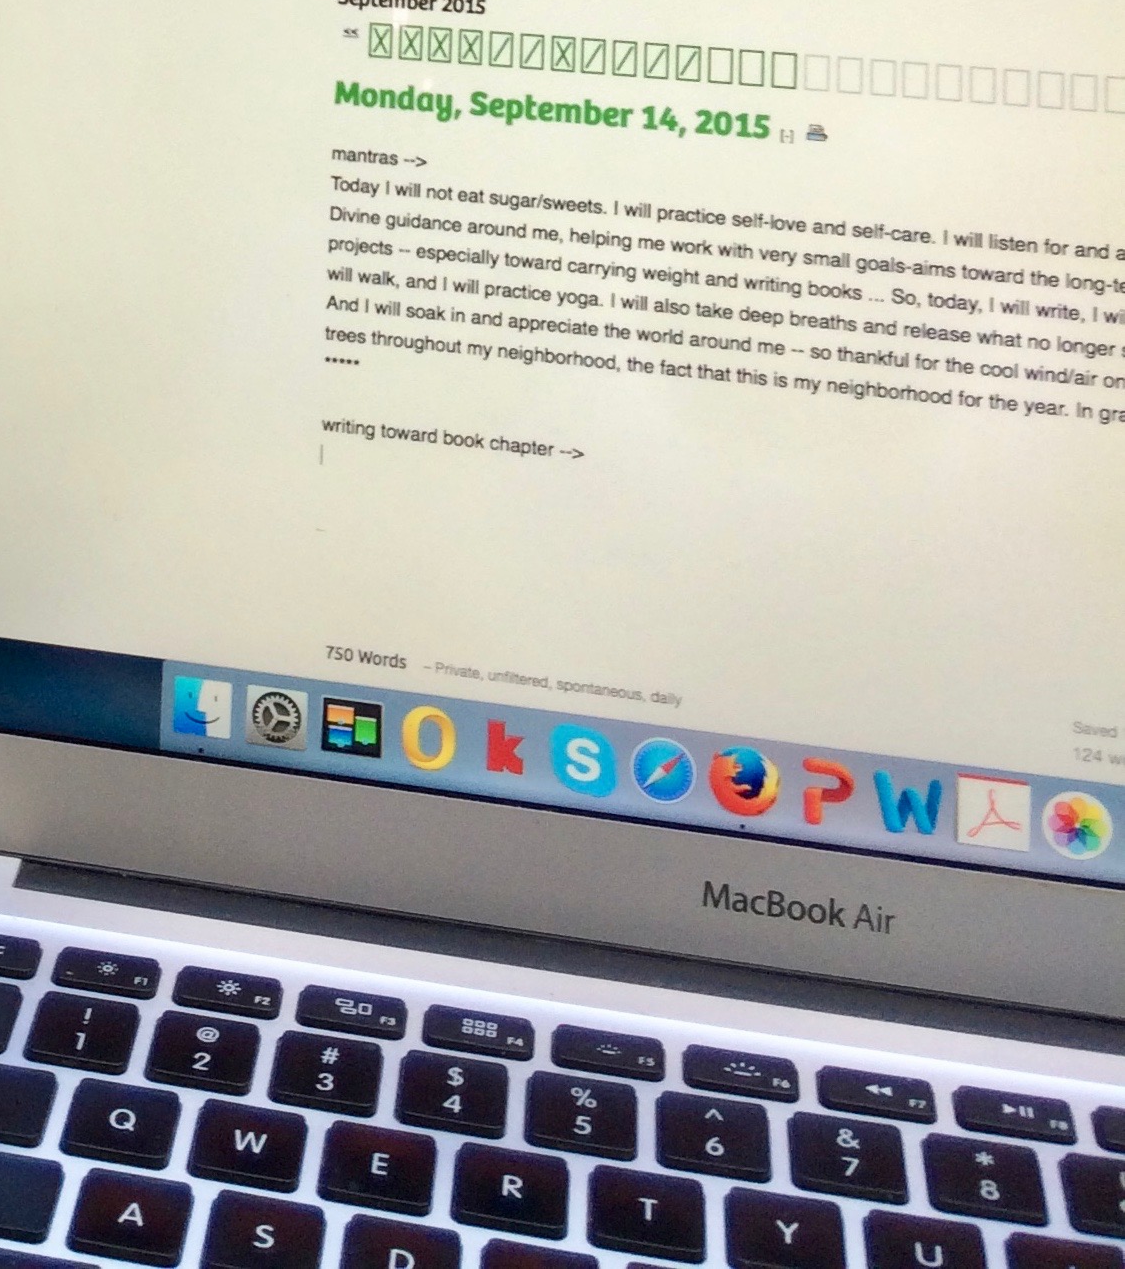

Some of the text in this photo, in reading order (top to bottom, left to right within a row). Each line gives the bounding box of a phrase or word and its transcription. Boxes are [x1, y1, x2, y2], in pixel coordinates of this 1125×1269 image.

[335, 80, 770, 140] Monday, September 14, 2015
[332, 149, 398, 166] mantras
[331, 175, 1109, 260] Today I will not eat sugar/sweets. I will practice self-love and self-care. I will listen for and
[330, 205, 381, 226] Divine
[385, 213, 462, 233] guidance
[467, 221, 527, 239] around
[532, 227, 563, 244] me,
[570, 228, 632, 253] helping
[638, 237, 665, 252] me
[670, 240, 713, 256] work
[718, 243, 753, 259] with
[759, 248, 797, 268] very
[803, 252, 850, 268] small
[856, 256, 956, 279] goals-aims
[961, 265, 1024, 285] toward
[1030, 270, 1060, 288] the
[328, 238, 1098, 324] projects especially toward carrying weight and writing books So, today, I will write, I
[325, 326, 366, 344] trees
[371, 330, 461, 354] throughout
[467, 343, 493, 361] my
[498, 346, 620, 373] neighborhood,
[627, 357, 654, 374] the
[660, 359, 692, 379] fact
[697, 364, 731, 382] that
[736, 368, 768, 387] this
[773, 371, 788, 389] is
[794, 377, 821, 395] my
[827, 380, 952, 405] neighborhood
[958, 390, 983, 408] for
[988, 393, 1018, 412] the
[1024, 400, 1068, 417] year.
[1076, 402, 1093, 419] In
[322, 420, 554, 458] writing toward book chapter
[326, 645, 406, 670] 750 Words
[703, 881, 896, 934] MacBook Air
[75, 1032, 87, 1051] 1
[191, 1051, 212, 1071] 2
[315, 1072, 334, 1091] 3
[442, 1094, 462, 1114] 4
[109, 1108, 137, 1132] Q
[573, 1115, 592, 1135] 5
[234, 1128, 268, 1154] W
[705, 1136, 725, 1156] 6
[370, 1152, 390, 1176] E
[841, 1156, 860, 1177] 7
[501, 1174, 523, 1199] R
[980, 1179, 1000, 1201] 8
[117, 1202, 144, 1227] A
[637, 1197, 659, 1221] T
[253, 1224, 275, 1249] S
[776, 1219, 799, 1245] Y
[914, 1241, 944, 1268] U
